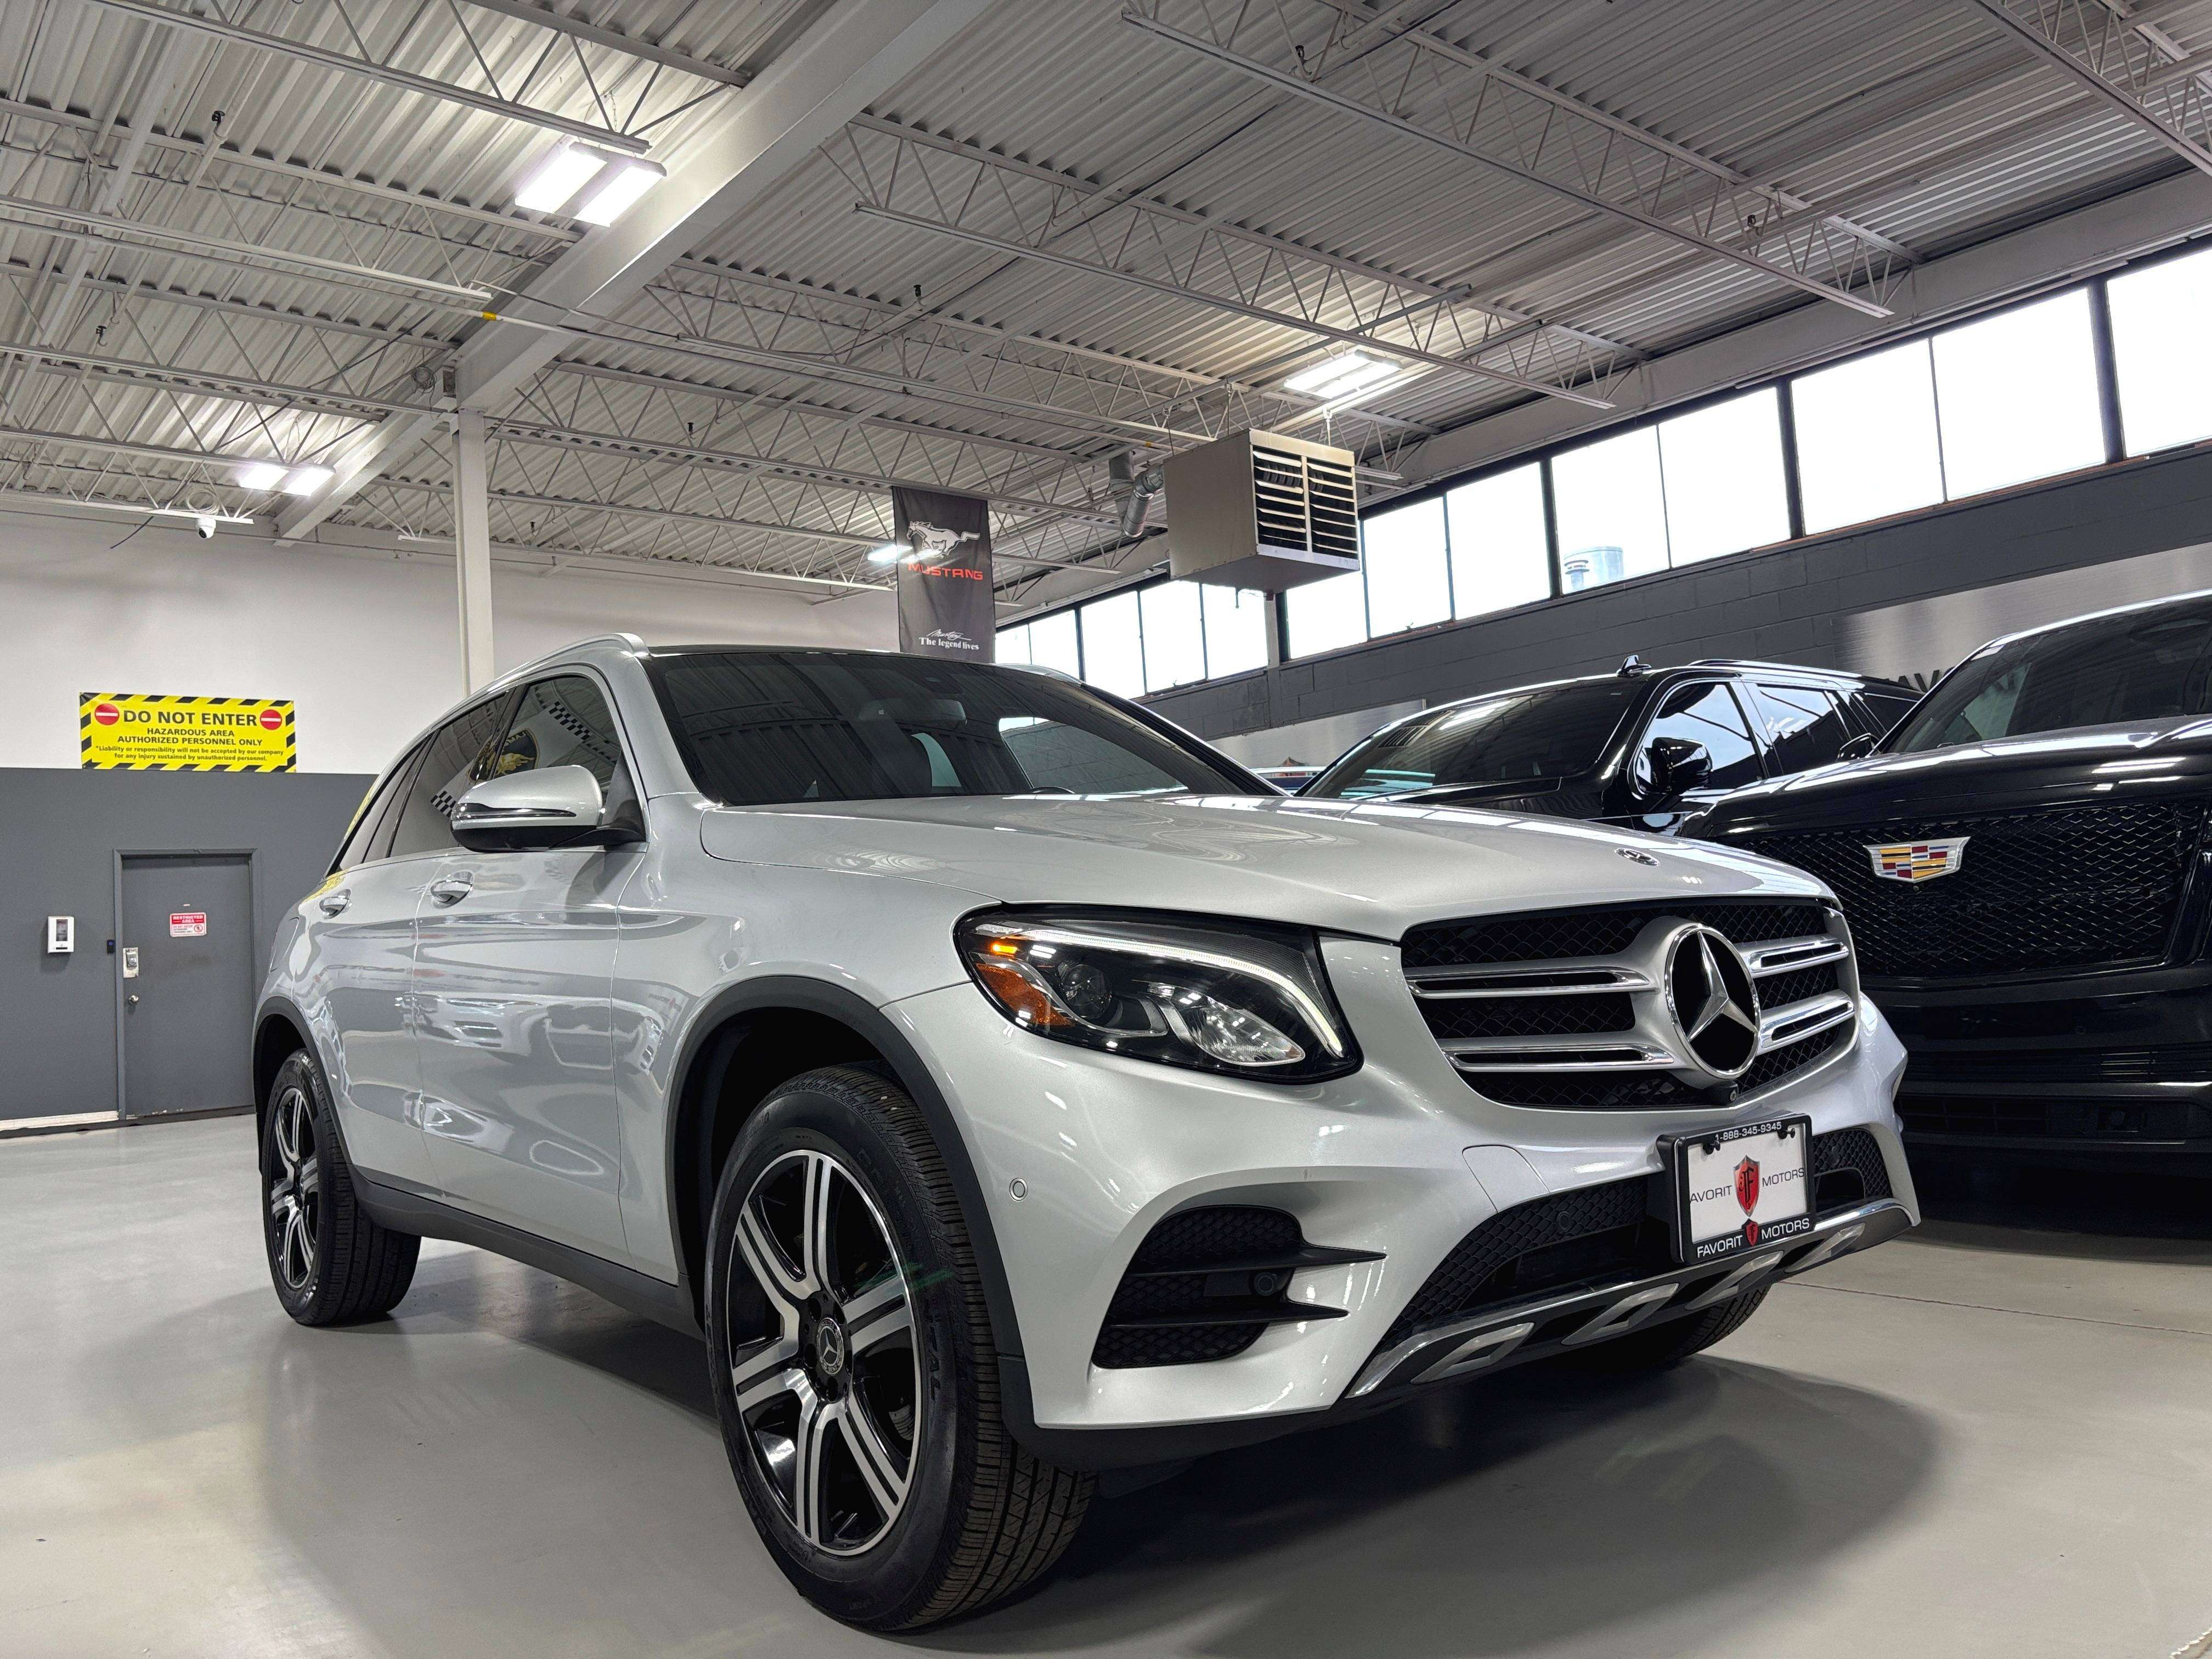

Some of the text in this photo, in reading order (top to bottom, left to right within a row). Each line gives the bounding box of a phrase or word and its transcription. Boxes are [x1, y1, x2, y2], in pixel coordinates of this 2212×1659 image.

[907, 561, 983, 580] MUSTANG
[919, 637, 979, 650] The legend lives
[123, 710, 257, 726] DO NOT ENTER
[147, 727, 207, 736] HAZARDOUS
[117, 736, 179, 744] AUTHORIZED
[182, 737, 236, 746] PERSONNEL
[1715, 1122, 1782, 1142] 1-888-345-9345
[1689, 1185, 1733, 1204] AVORIT
[1762, 1167, 1805, 1188] MOTORS
[1697, 1235, 1743, 1259] FAVORIT
[1761, 1218, 1810, 1240] MOTORS
